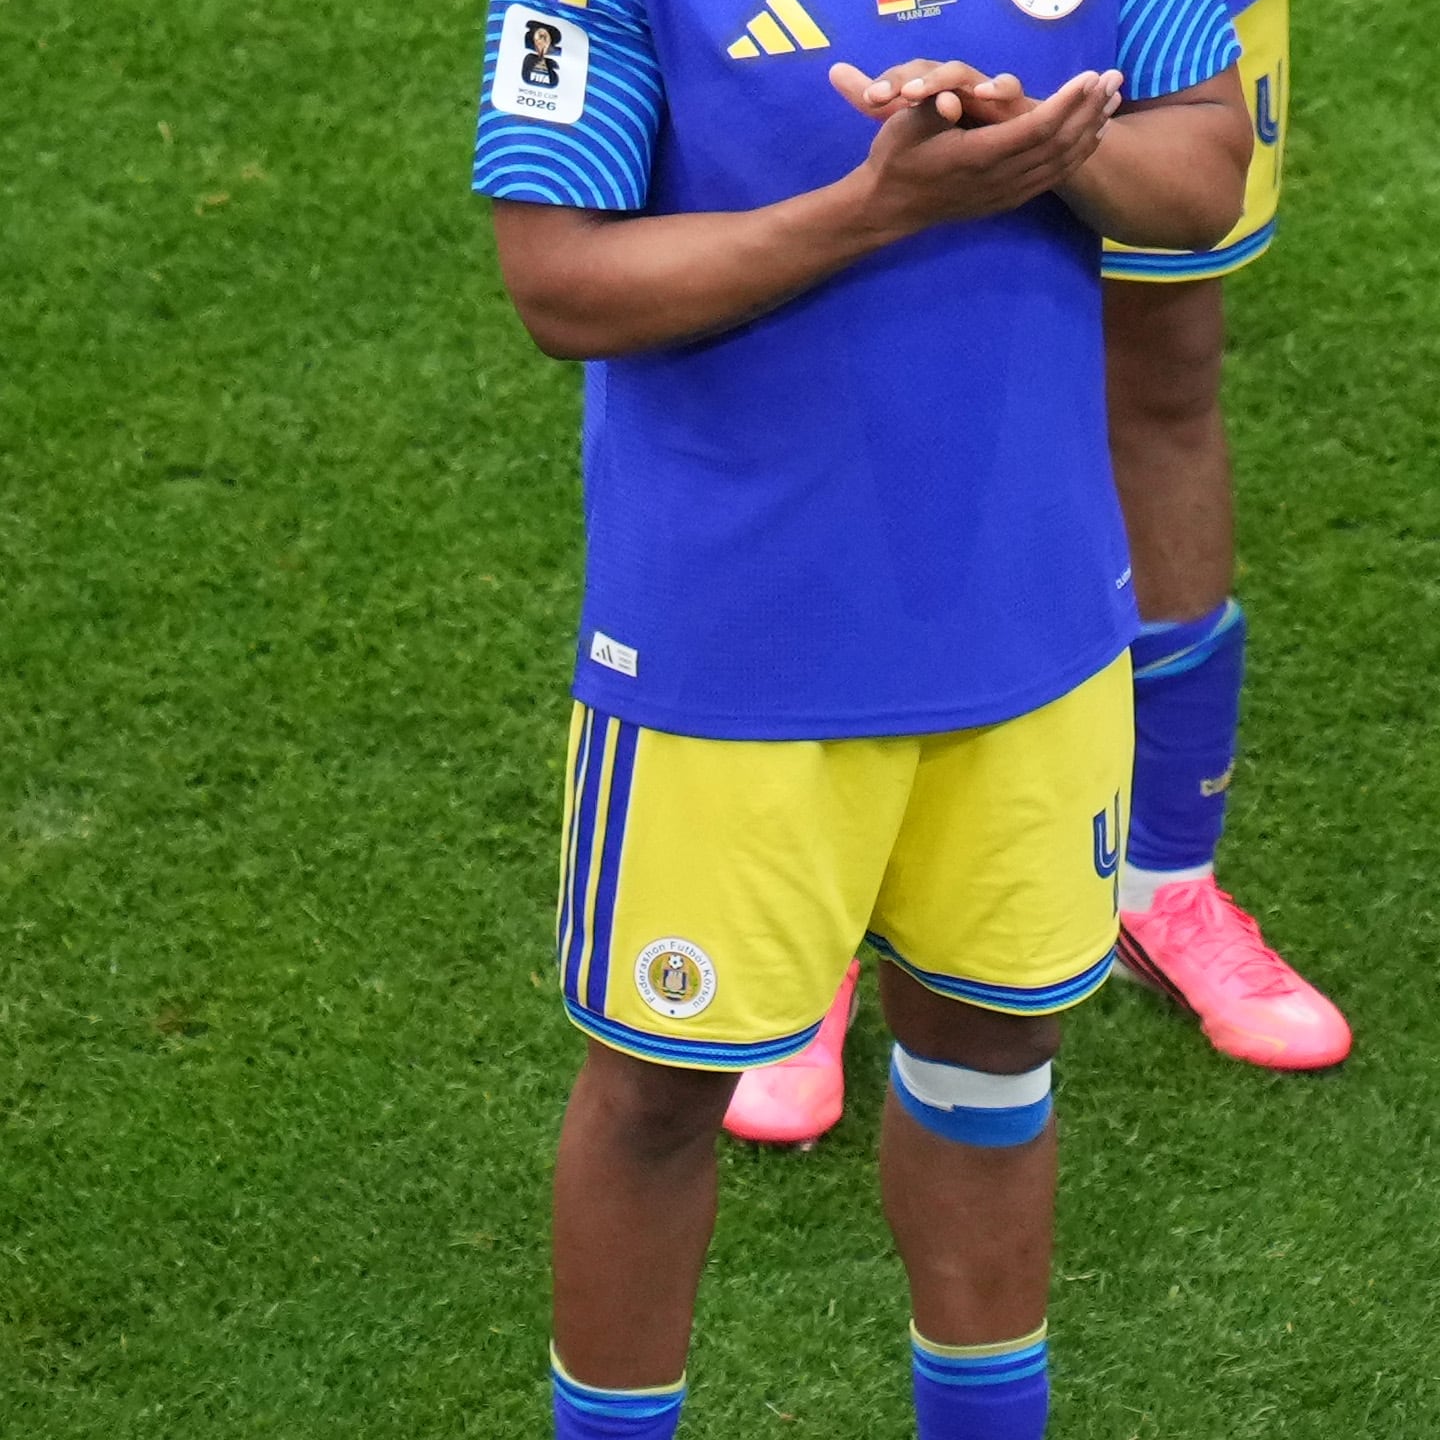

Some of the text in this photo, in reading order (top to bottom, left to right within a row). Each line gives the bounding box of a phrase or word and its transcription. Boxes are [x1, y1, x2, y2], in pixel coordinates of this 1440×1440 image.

[516, 94, 557, 112] 2026
[638, 943, 666, 1004] Federashon
[669, 940, 706, 966] Futbol
